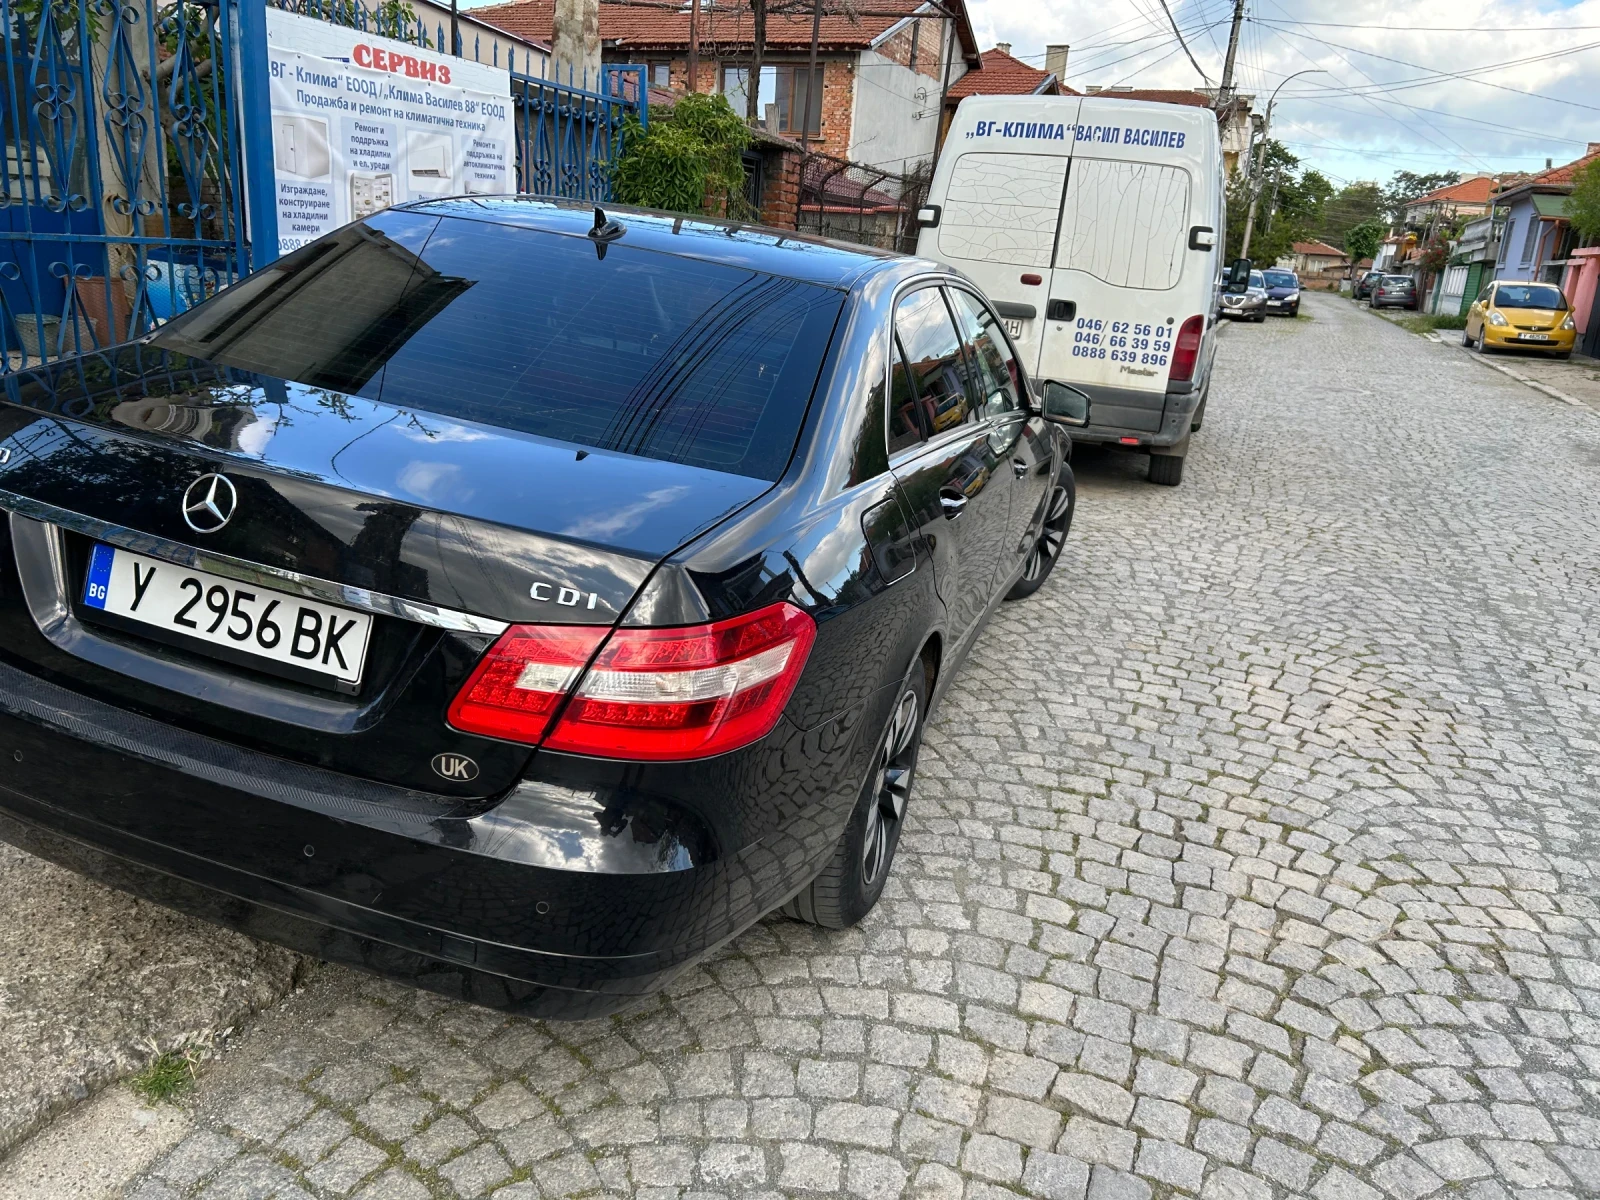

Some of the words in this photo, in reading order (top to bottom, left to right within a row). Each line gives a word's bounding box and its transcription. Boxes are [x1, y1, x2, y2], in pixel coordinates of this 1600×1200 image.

[353, 44, 451, 84] СЕРВИЗ
[346, 76, 377, 99] ЕООД
[425, 92, 463, 111] Василев
[481, 102, 505, 121] ЕООД
[296, 89, 348, 110] Продажба
[351, 102, 357, 111] и
[360, 103, 392, 118] ремонт
[394, 109, 404, 119] на
[405, 111, 454, 127] климатична
[455, 119, 486, 132] техника
[354, 122, 379, 134] Ремонт
[350, 135, 389, 147] поддръжка
[1076, 125, 1120, 144] ВАСИЛ
[1123, 128, 1186, 149] ВАСИЛЕВ
[473, 139, 491, 149] Ремонт
[349, 147, 358, 155] на
[359, 148, 391, 159] хладилни
[466, 150, 496, 160] поддръжка
[353, 159, 358, 167] и
[370, 161, 390, 171] уреди
[463, 160, 506, 171] автоклиматична
[474, 172, 496, 180] техника
[280, 183, 328, 197] Изграждане,
[278, 198, 330, 210] конструиране
[282, 211, 292, 219] на
[293, 211, 328, 221] хладилни
[292, 224, 321, 234] камери
[1076, 318, 1108, 333] 046/
[1112, 321, 1129, 334] 62
[1134, 323, 1151, 336] 56
[1155, 326, 1172, 339] 01
[1074, 331, 1106, 347] 046/
[1109, 335, 1126, 348] 66
[1131, 338, 1149, 350] 39
[1153, 340, 1171, 353] 59
[1072, 345, 1106, 359] 0888
[1111, 349, 1136, 363] 639
[1141, 353, 1168, 366] 896
[1119, 365, 1158, 377] Master
[88, 582, 106, 600] BG
[529, 582, 598, 610] CDI
[173, 577, 282, 650] 2956
[290, 613, 357, 671] BK
[441, 756, 469, 779] UK
